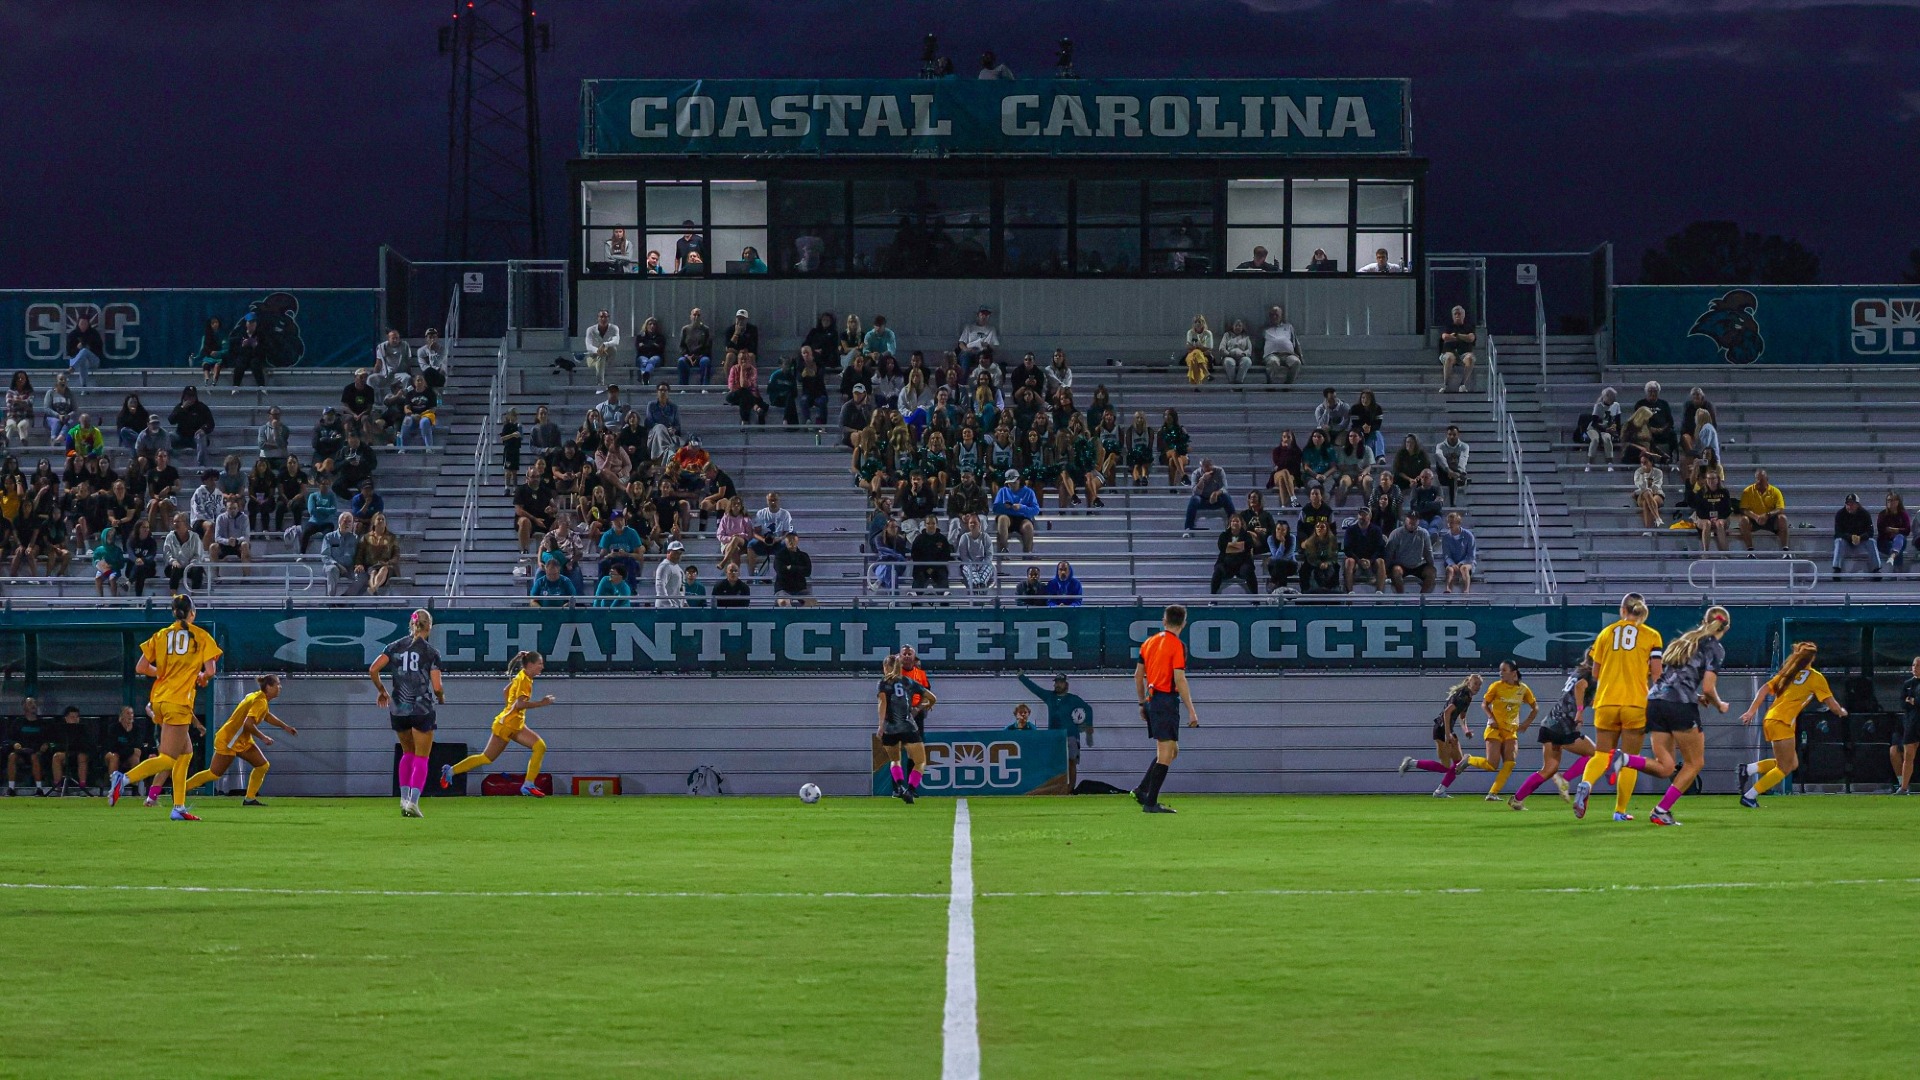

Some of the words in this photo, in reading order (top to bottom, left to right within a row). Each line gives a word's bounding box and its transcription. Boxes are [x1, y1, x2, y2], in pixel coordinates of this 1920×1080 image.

[630, 95, 952, 138] COASTAL
[1001, 94, 1376, 138] CAROLINA
[166, 629, 190, 655] 10
[428, 620, 1073, 662] CHANTICLEER
[1613, 624, 1639, 651] 18
[400, 650, 420, 672] 18
[894, 682, 904, 697] 6
[920, 741, 1021, 789] SBC
